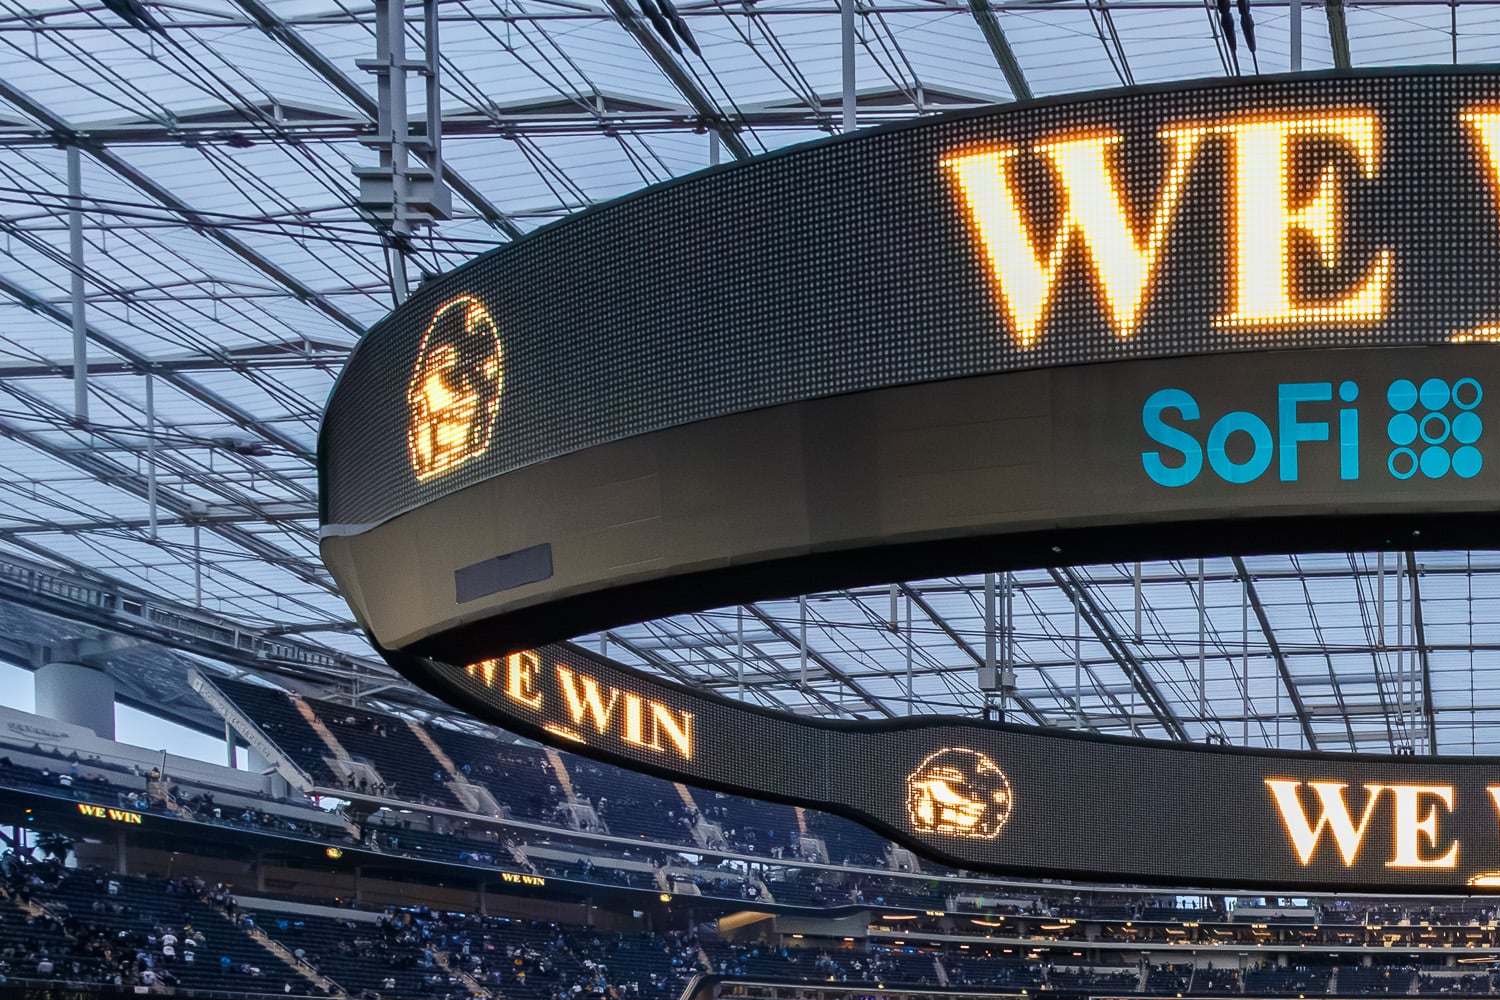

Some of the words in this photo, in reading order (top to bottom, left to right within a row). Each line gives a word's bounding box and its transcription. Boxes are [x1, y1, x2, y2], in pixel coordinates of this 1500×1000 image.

[939, 106, 1393, 350] WE
[1141, 379, 1361, 489] SoFi
[555, 664, 695, 761] WIN
[78, 803, 106, 818] WE
[107, 808, 142, 824] WIN
[1264, 780, 1459, 868] WE
[501, 872, 521, 883] WE
[521, 875, 545, 886] WIN
